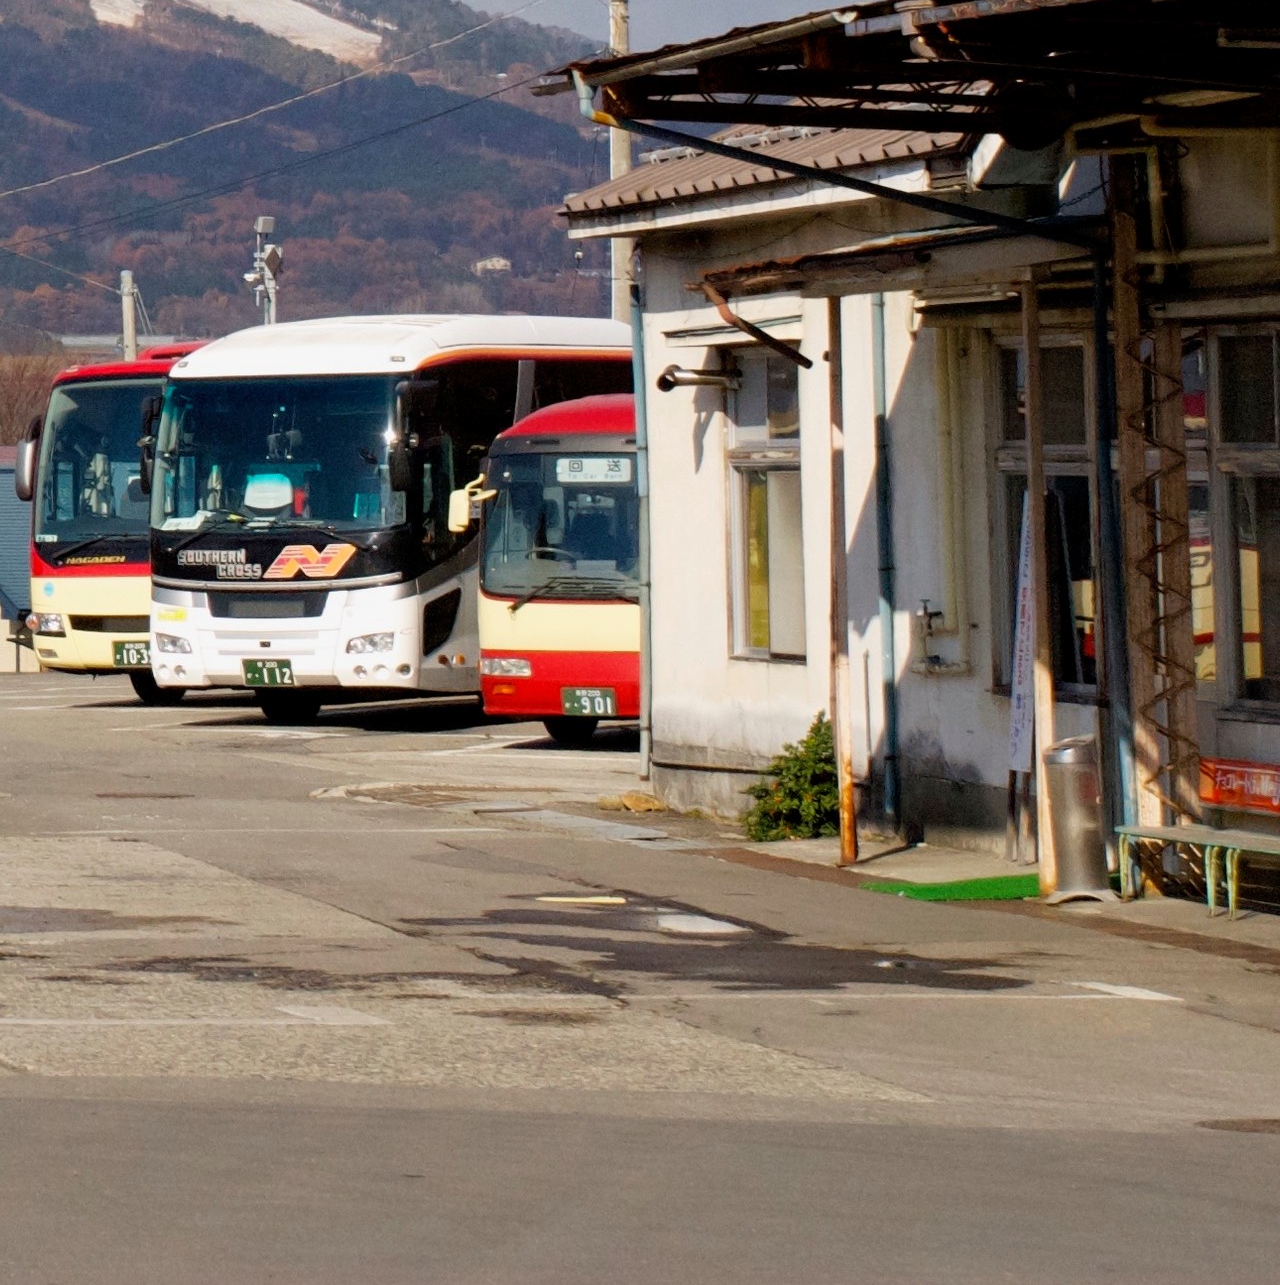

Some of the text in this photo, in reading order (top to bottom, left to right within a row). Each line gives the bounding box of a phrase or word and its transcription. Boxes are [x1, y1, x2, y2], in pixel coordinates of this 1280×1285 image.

[568, 459, 622, 473] 回送
[65, 555, 126, 564] NAGADEN
[178, 548, 247, 565] SOUTHERN
[216, 563, 262, 580] CROSS
[122, 649, 151, 665] 10-3
